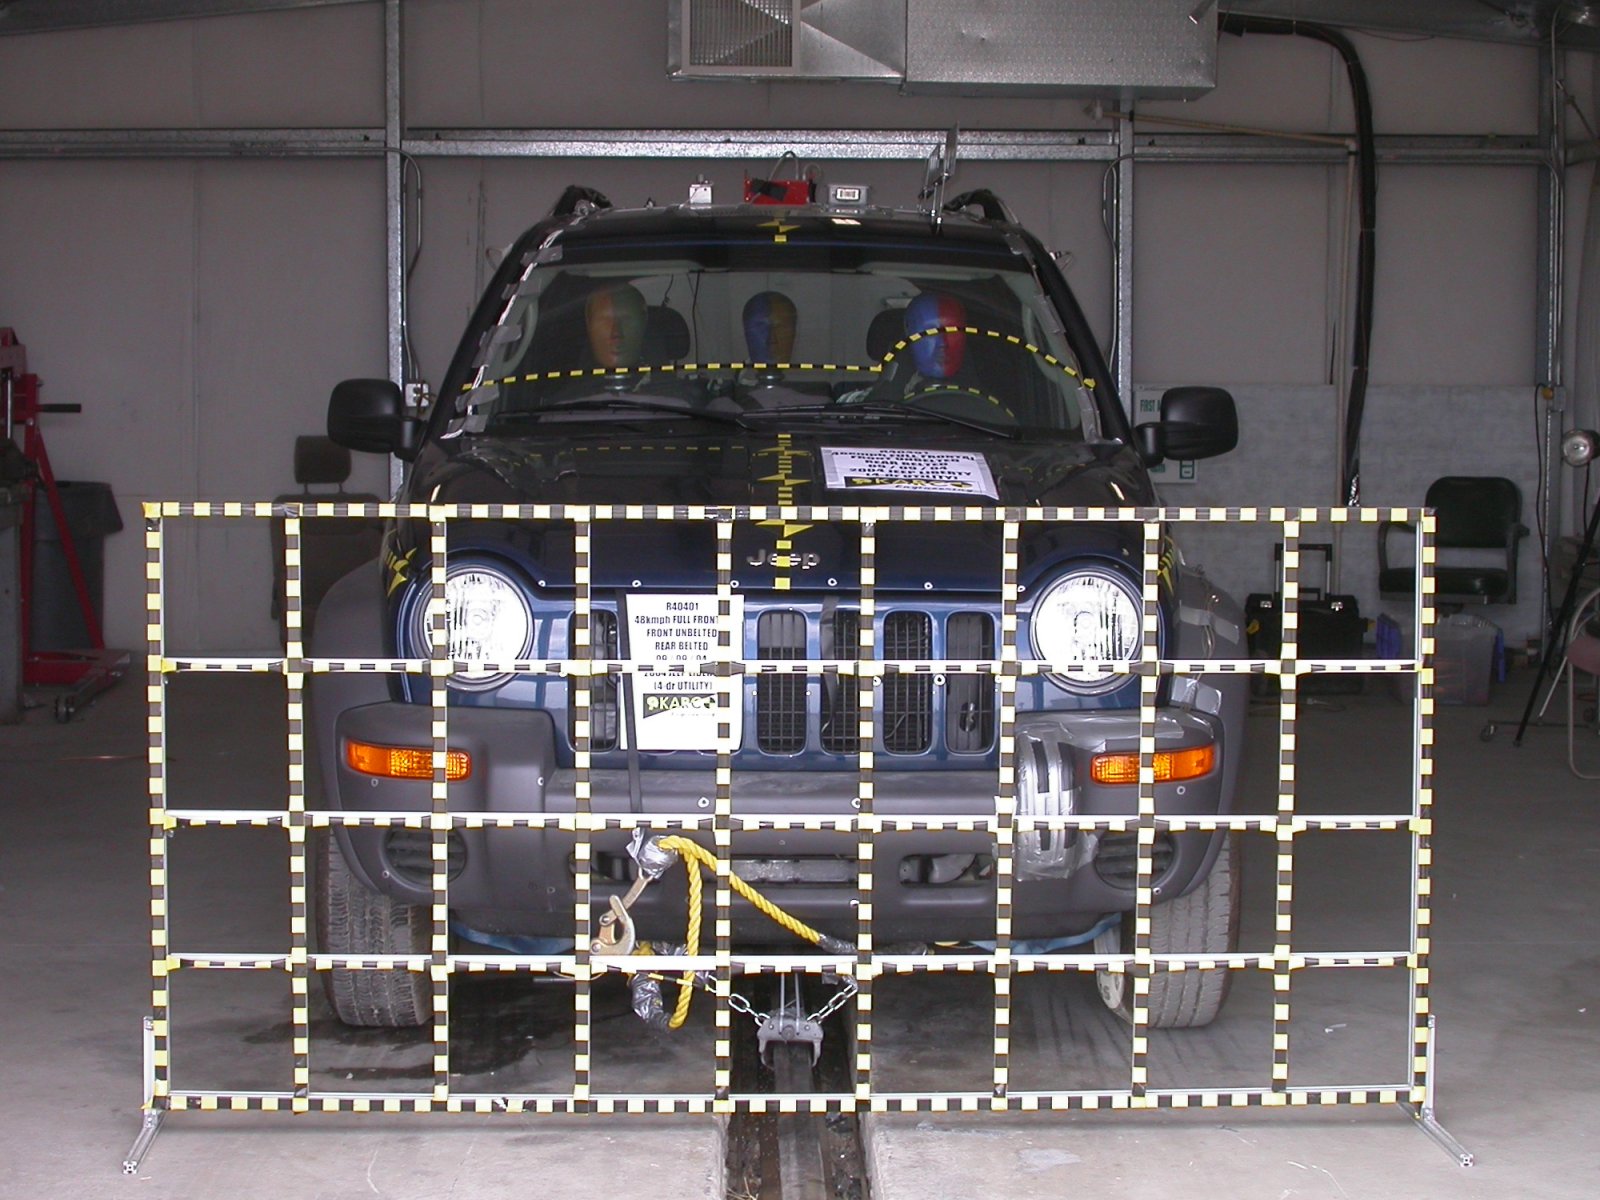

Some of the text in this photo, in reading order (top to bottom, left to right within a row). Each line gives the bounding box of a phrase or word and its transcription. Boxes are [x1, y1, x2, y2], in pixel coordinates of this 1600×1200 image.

[746, 549, 820, 569] Jeep
[666, 601, 699, 611] R40401
[634, 615, 719, 625] 48kmph FULL FRONT
[646, 628, 718, 637] FRONT UNBELTED
[655, 641, 709, 651] REAR BELTED
